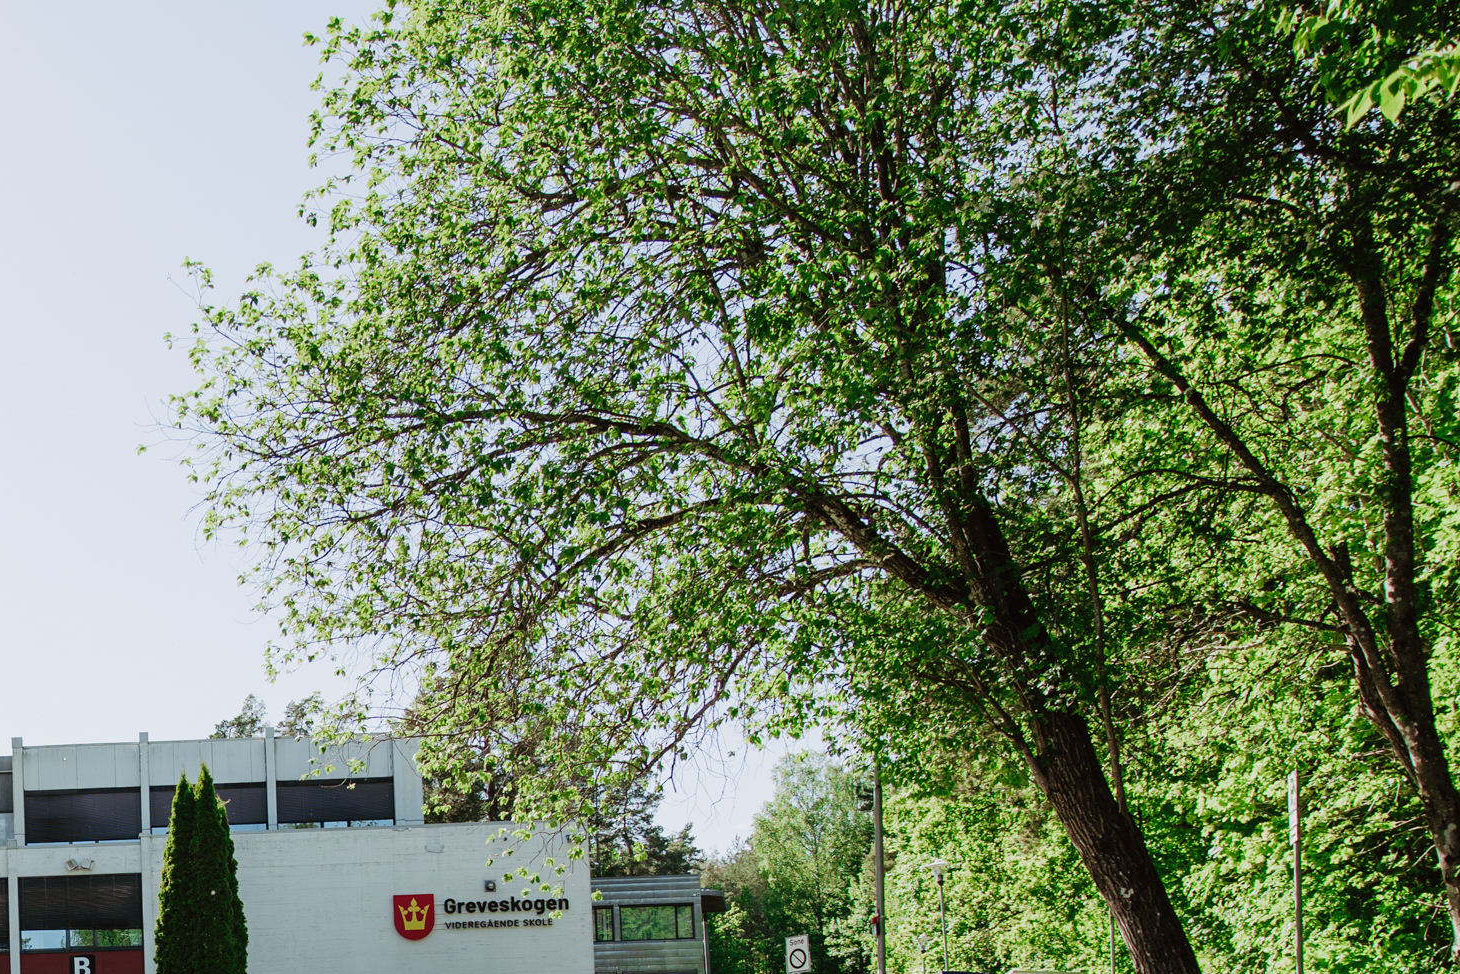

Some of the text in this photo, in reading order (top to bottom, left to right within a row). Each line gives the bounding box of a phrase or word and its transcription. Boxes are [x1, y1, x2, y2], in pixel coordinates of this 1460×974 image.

[444, 896, 570, 915] Greveskogen
[445, 918, 553, 929] VIDEREGÅENDE SKOLE
